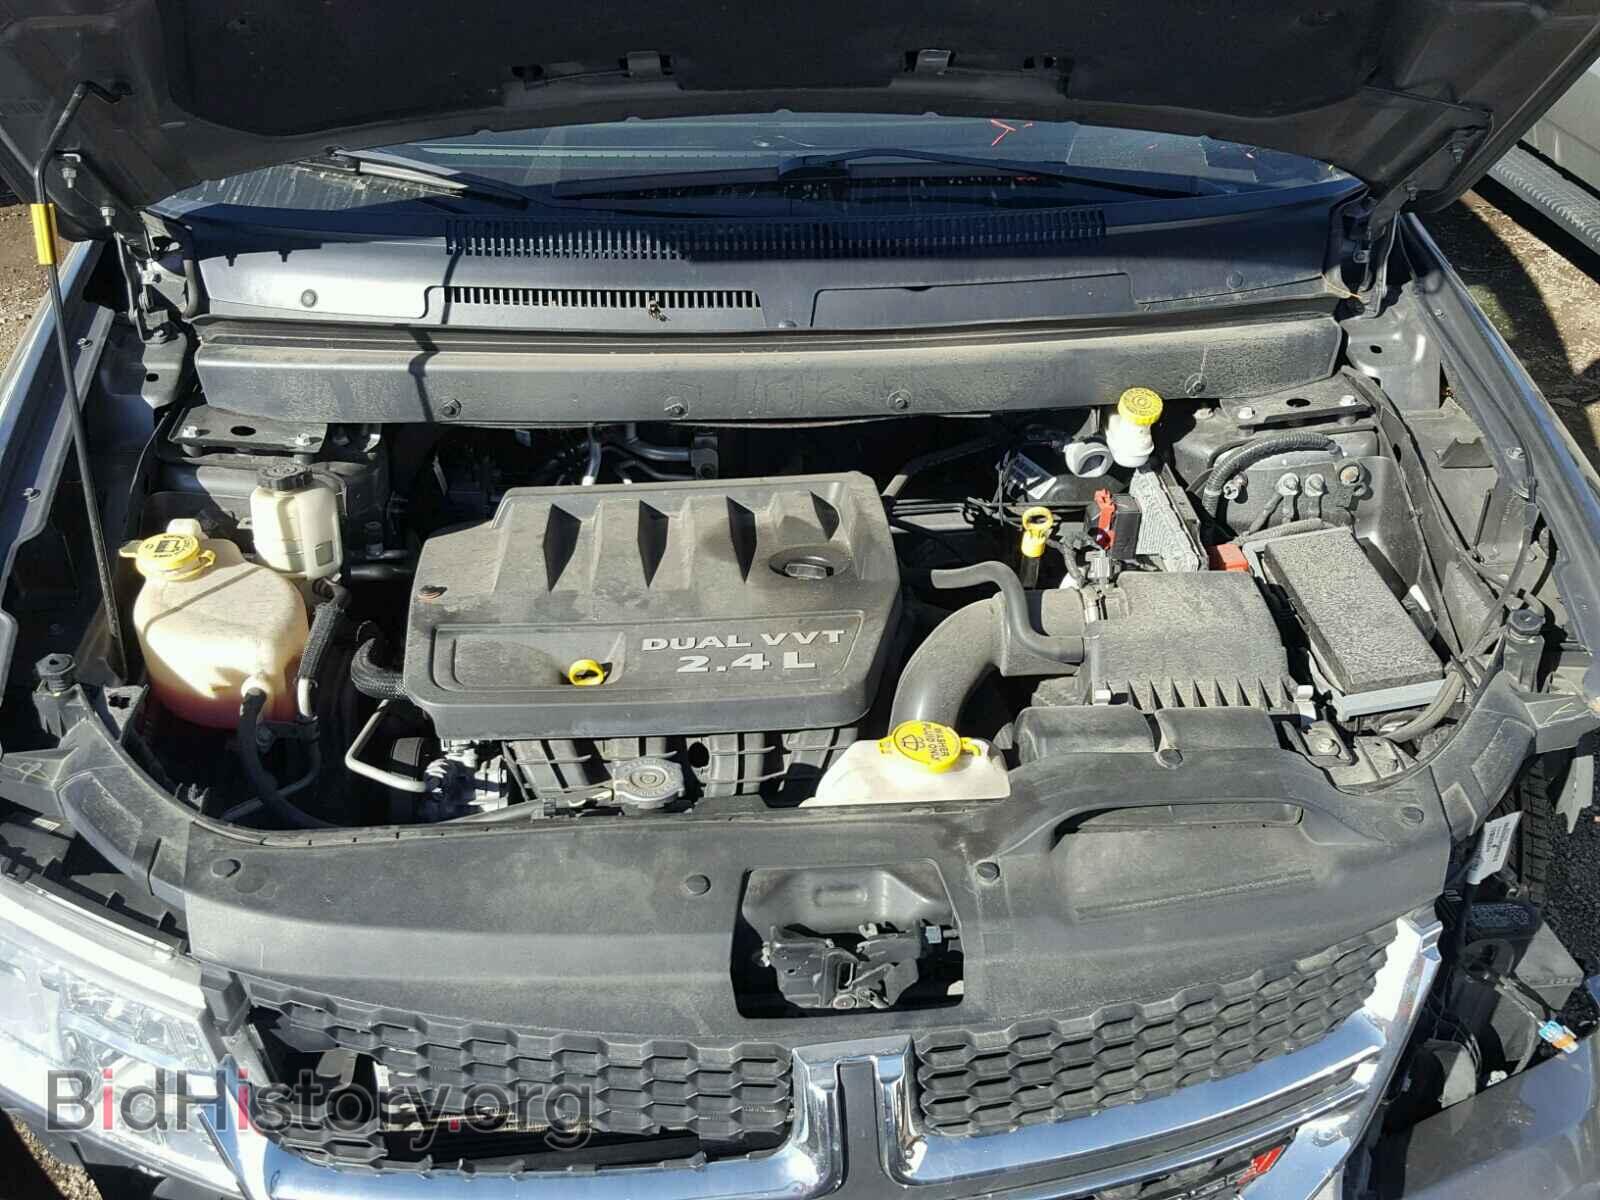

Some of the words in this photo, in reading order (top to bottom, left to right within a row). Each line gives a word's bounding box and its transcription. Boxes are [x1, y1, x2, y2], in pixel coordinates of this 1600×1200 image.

[642, 634, 752, 651] DUAL
[760, 629, 846, 646] VVT
[676, 653, 771, 673] 2.4
[783, 651, 817, 671] L
